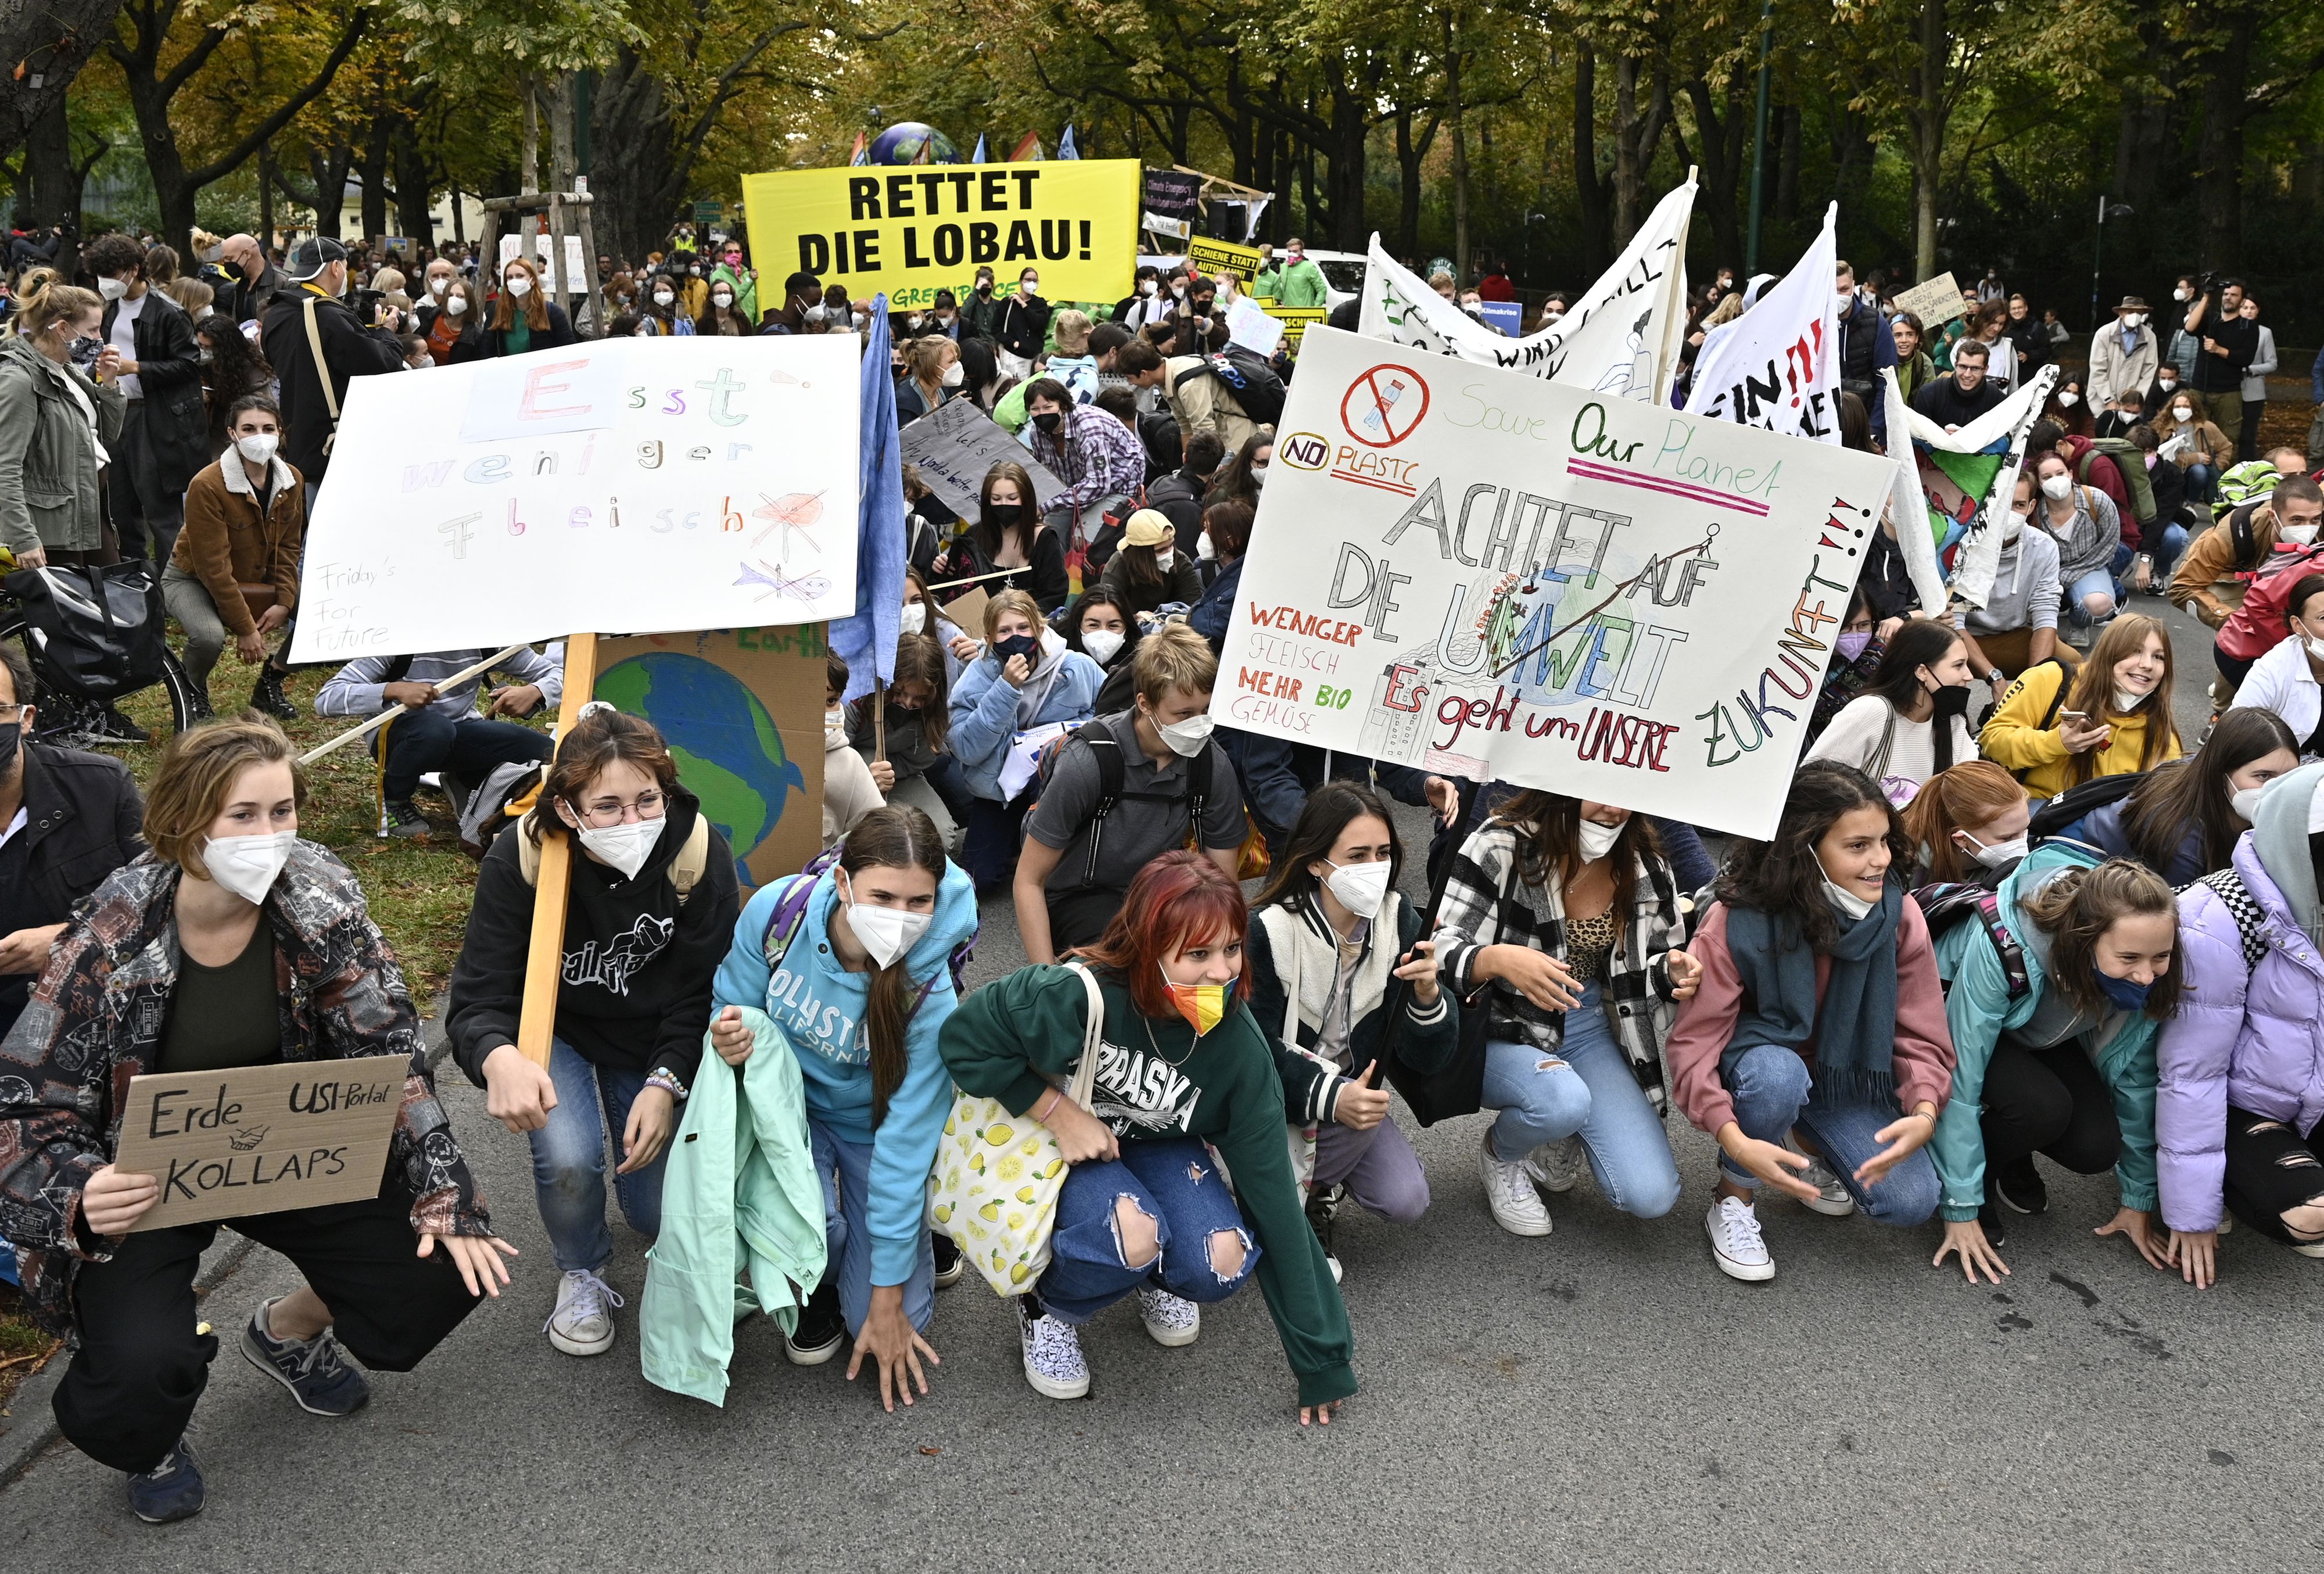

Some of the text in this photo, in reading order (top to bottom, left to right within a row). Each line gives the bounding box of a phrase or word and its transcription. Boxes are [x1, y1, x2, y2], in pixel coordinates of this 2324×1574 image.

[849, 171, 1039, 220] RETTET
[799, 220, 1091, 275] DIE LOBAU!
[1193, 247, 1257, 268] SCHIENE STATT
[1493, 334, 1563, 367] WIND
[1285, 437, 1327, 465] NO
[1571, 402, 1644, 462] Our
[1653, 419, 1782, 497] Planet
[1382, 477, 1633, 590] ACHTET
[316, 556, 396, 592] Friday's
[1328, 542, 1719, 643] DIE AUF
[313, 598, 361, 623] For
[1250, 601, 1362, 647] WENIGER
[311, 624, 390, 651] Future
[1249, 632, 1339, 675] FLEISCH
[1436, 584, 1689, 709] UMWELT
[1238, 666, 1352, 710] MEHR BIO
[1231, 695, 1318, 734] GEMÜSE
[1383, 663, 1680, 772] Es geht um UNSERE
[768, 969, 870, 1051] OLLISTE
[1069, 1039, 1202, 1132] BRASKA
[149, 1084, 242, 1139] Erde
[163, 1147, 348, 1203] KOLLAPS
